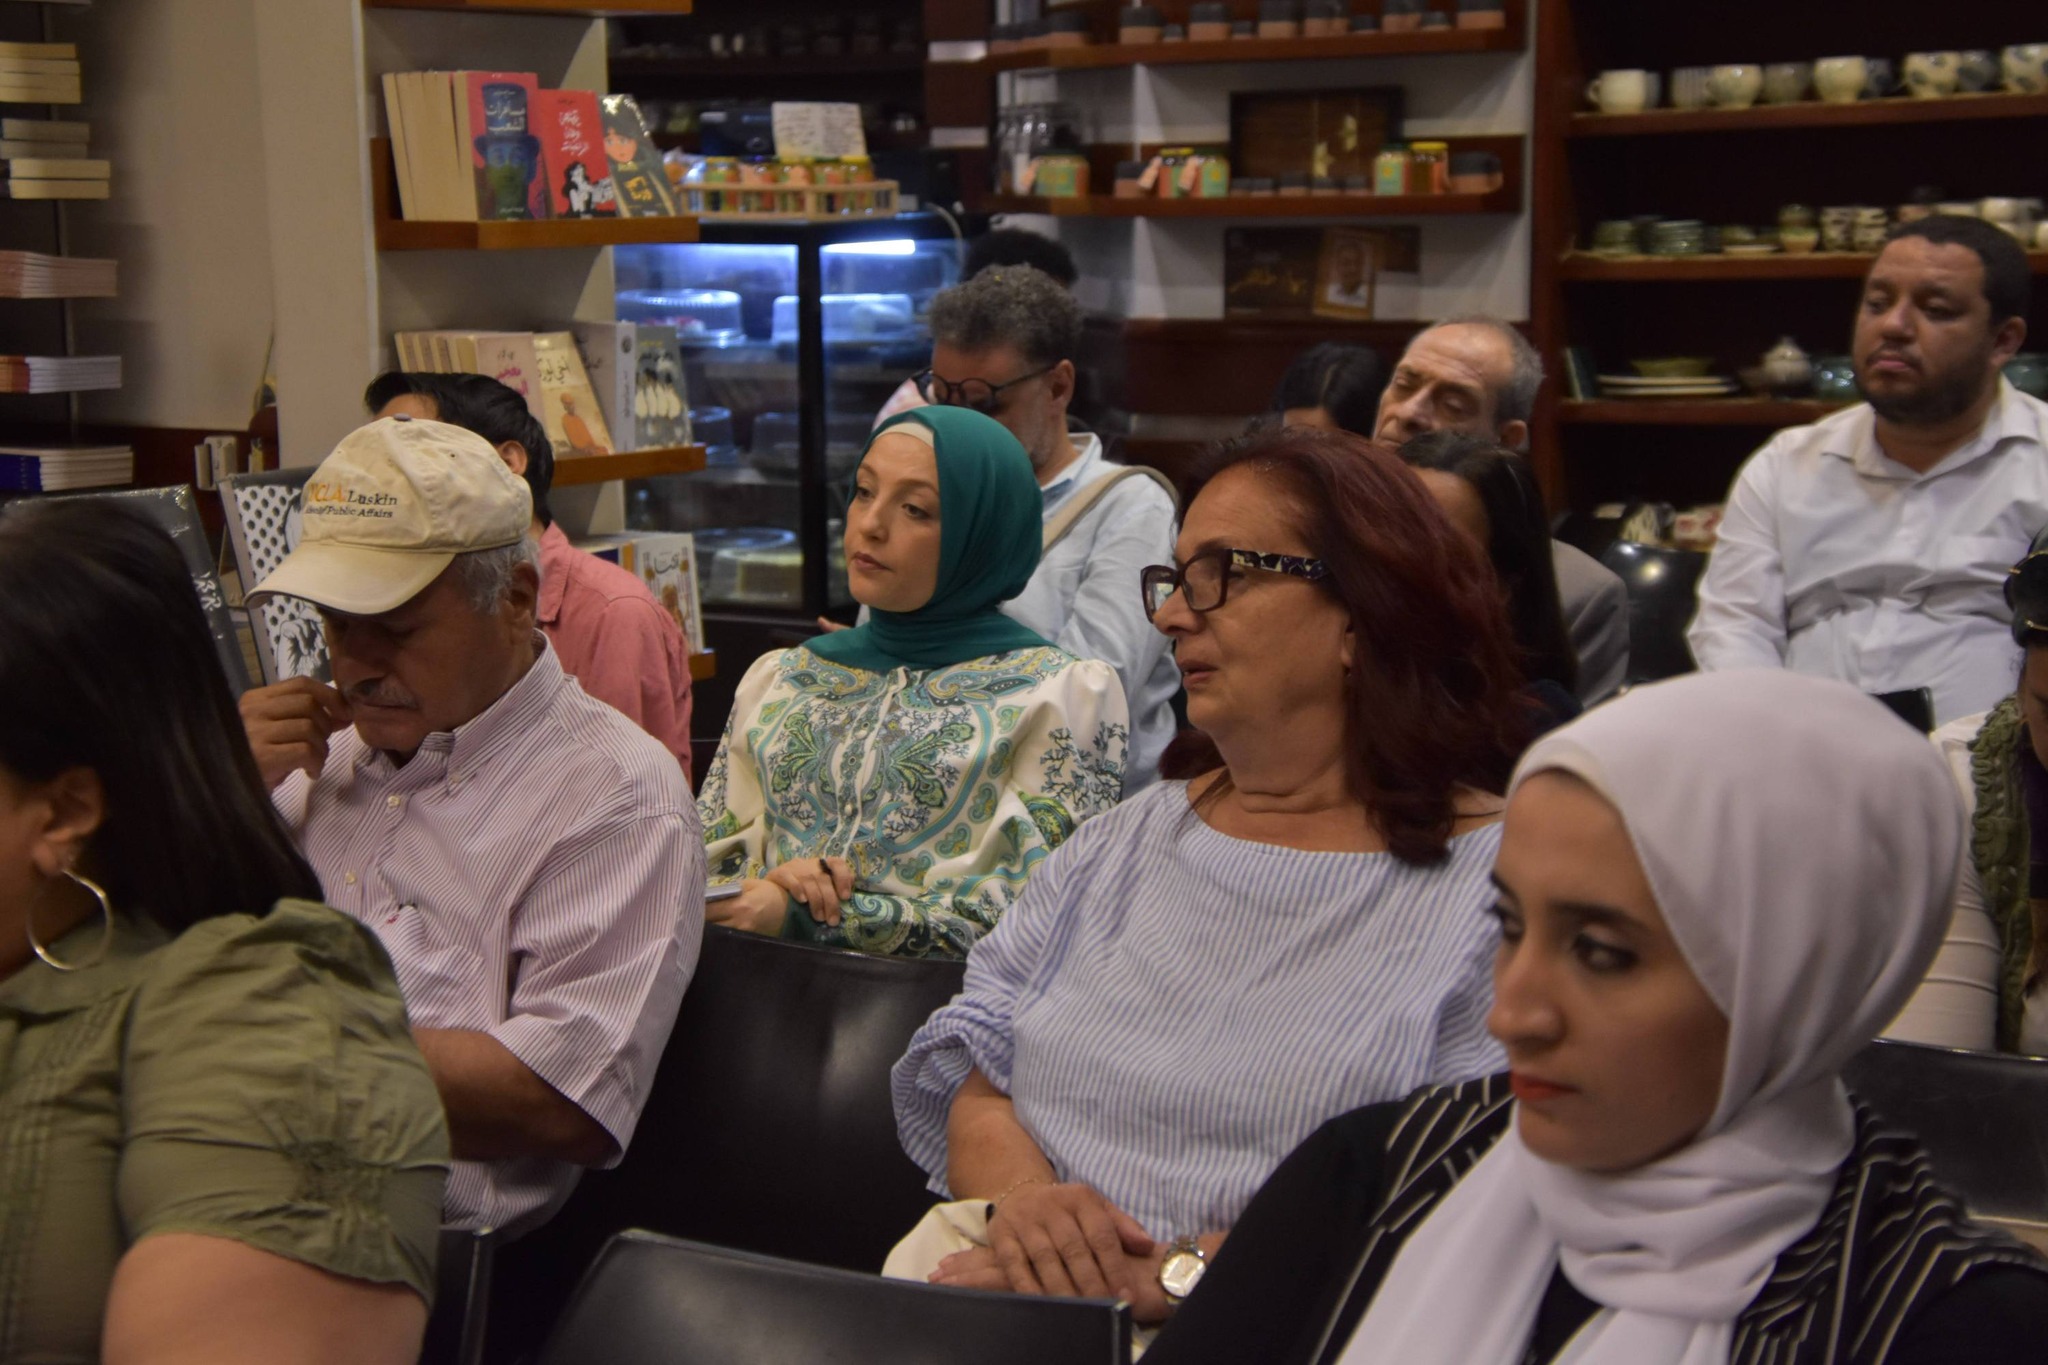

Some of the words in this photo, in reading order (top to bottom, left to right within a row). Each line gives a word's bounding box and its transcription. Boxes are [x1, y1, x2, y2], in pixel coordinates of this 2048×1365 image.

[347, 490, 398, 506] Luskin
[327, 505, 356, 516] Public
[358, 506, 393, 518] Affairs
